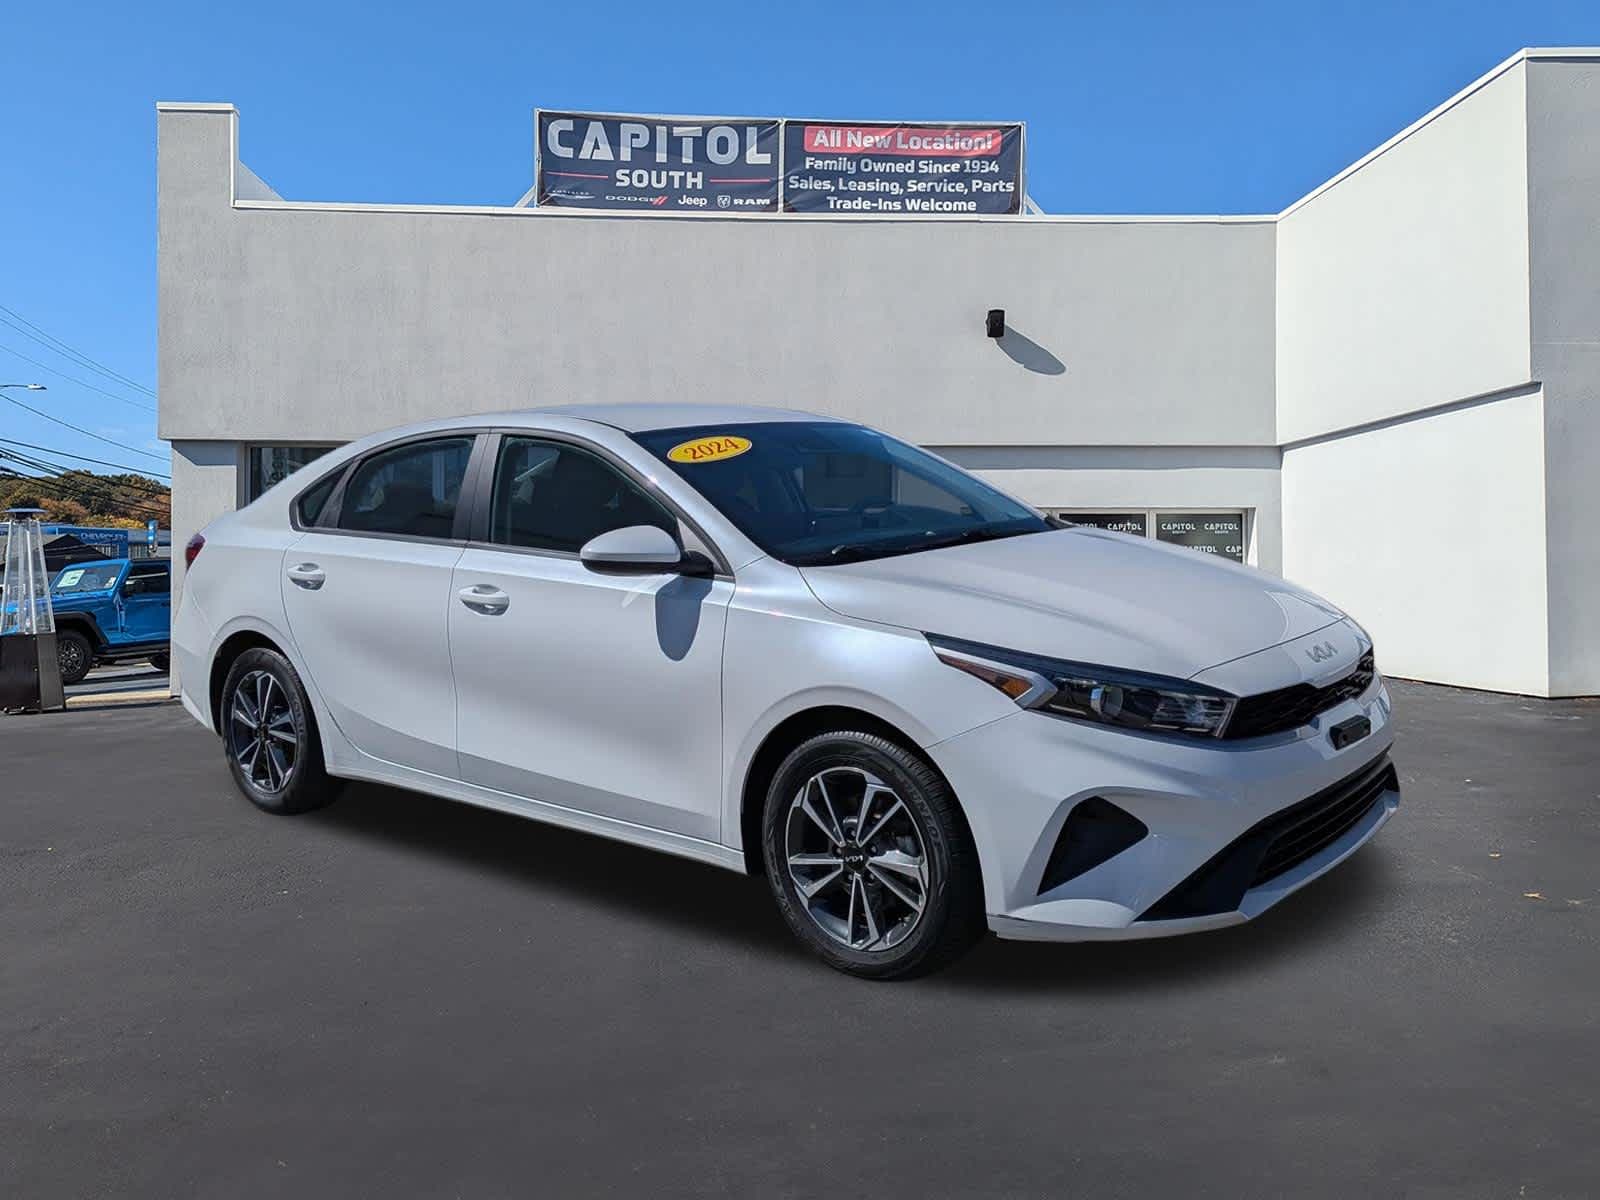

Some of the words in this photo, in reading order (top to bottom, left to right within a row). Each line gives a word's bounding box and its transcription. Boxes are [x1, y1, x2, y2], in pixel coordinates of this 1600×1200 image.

[547, 119, 771, 165] CAPITOL
[813, 130, 841, 147] All
[847, 131, 892, 148] New
[896, 132, 993, 150] Location!
[805, 157, 857, 174] Family
[860, 159, 915, 173] Owned
[918, 160, 960, 173] Since
[963, 160, 999, 173] 1934
[615, 169, 703, 189] SOUTH
[789, 176, 835, 192] Sales,
[838, 178, 904, 195] Leasing,
[907, 179, 969, 195] Service,
[971, 180, 1015, 192] Parts
[678, 195, 708, 207] Jeep
[826, 196, 902, 210] Trade-Ins
[905, 198, 977, 211] Welcome
[684, 438, 740, 460] 2024
